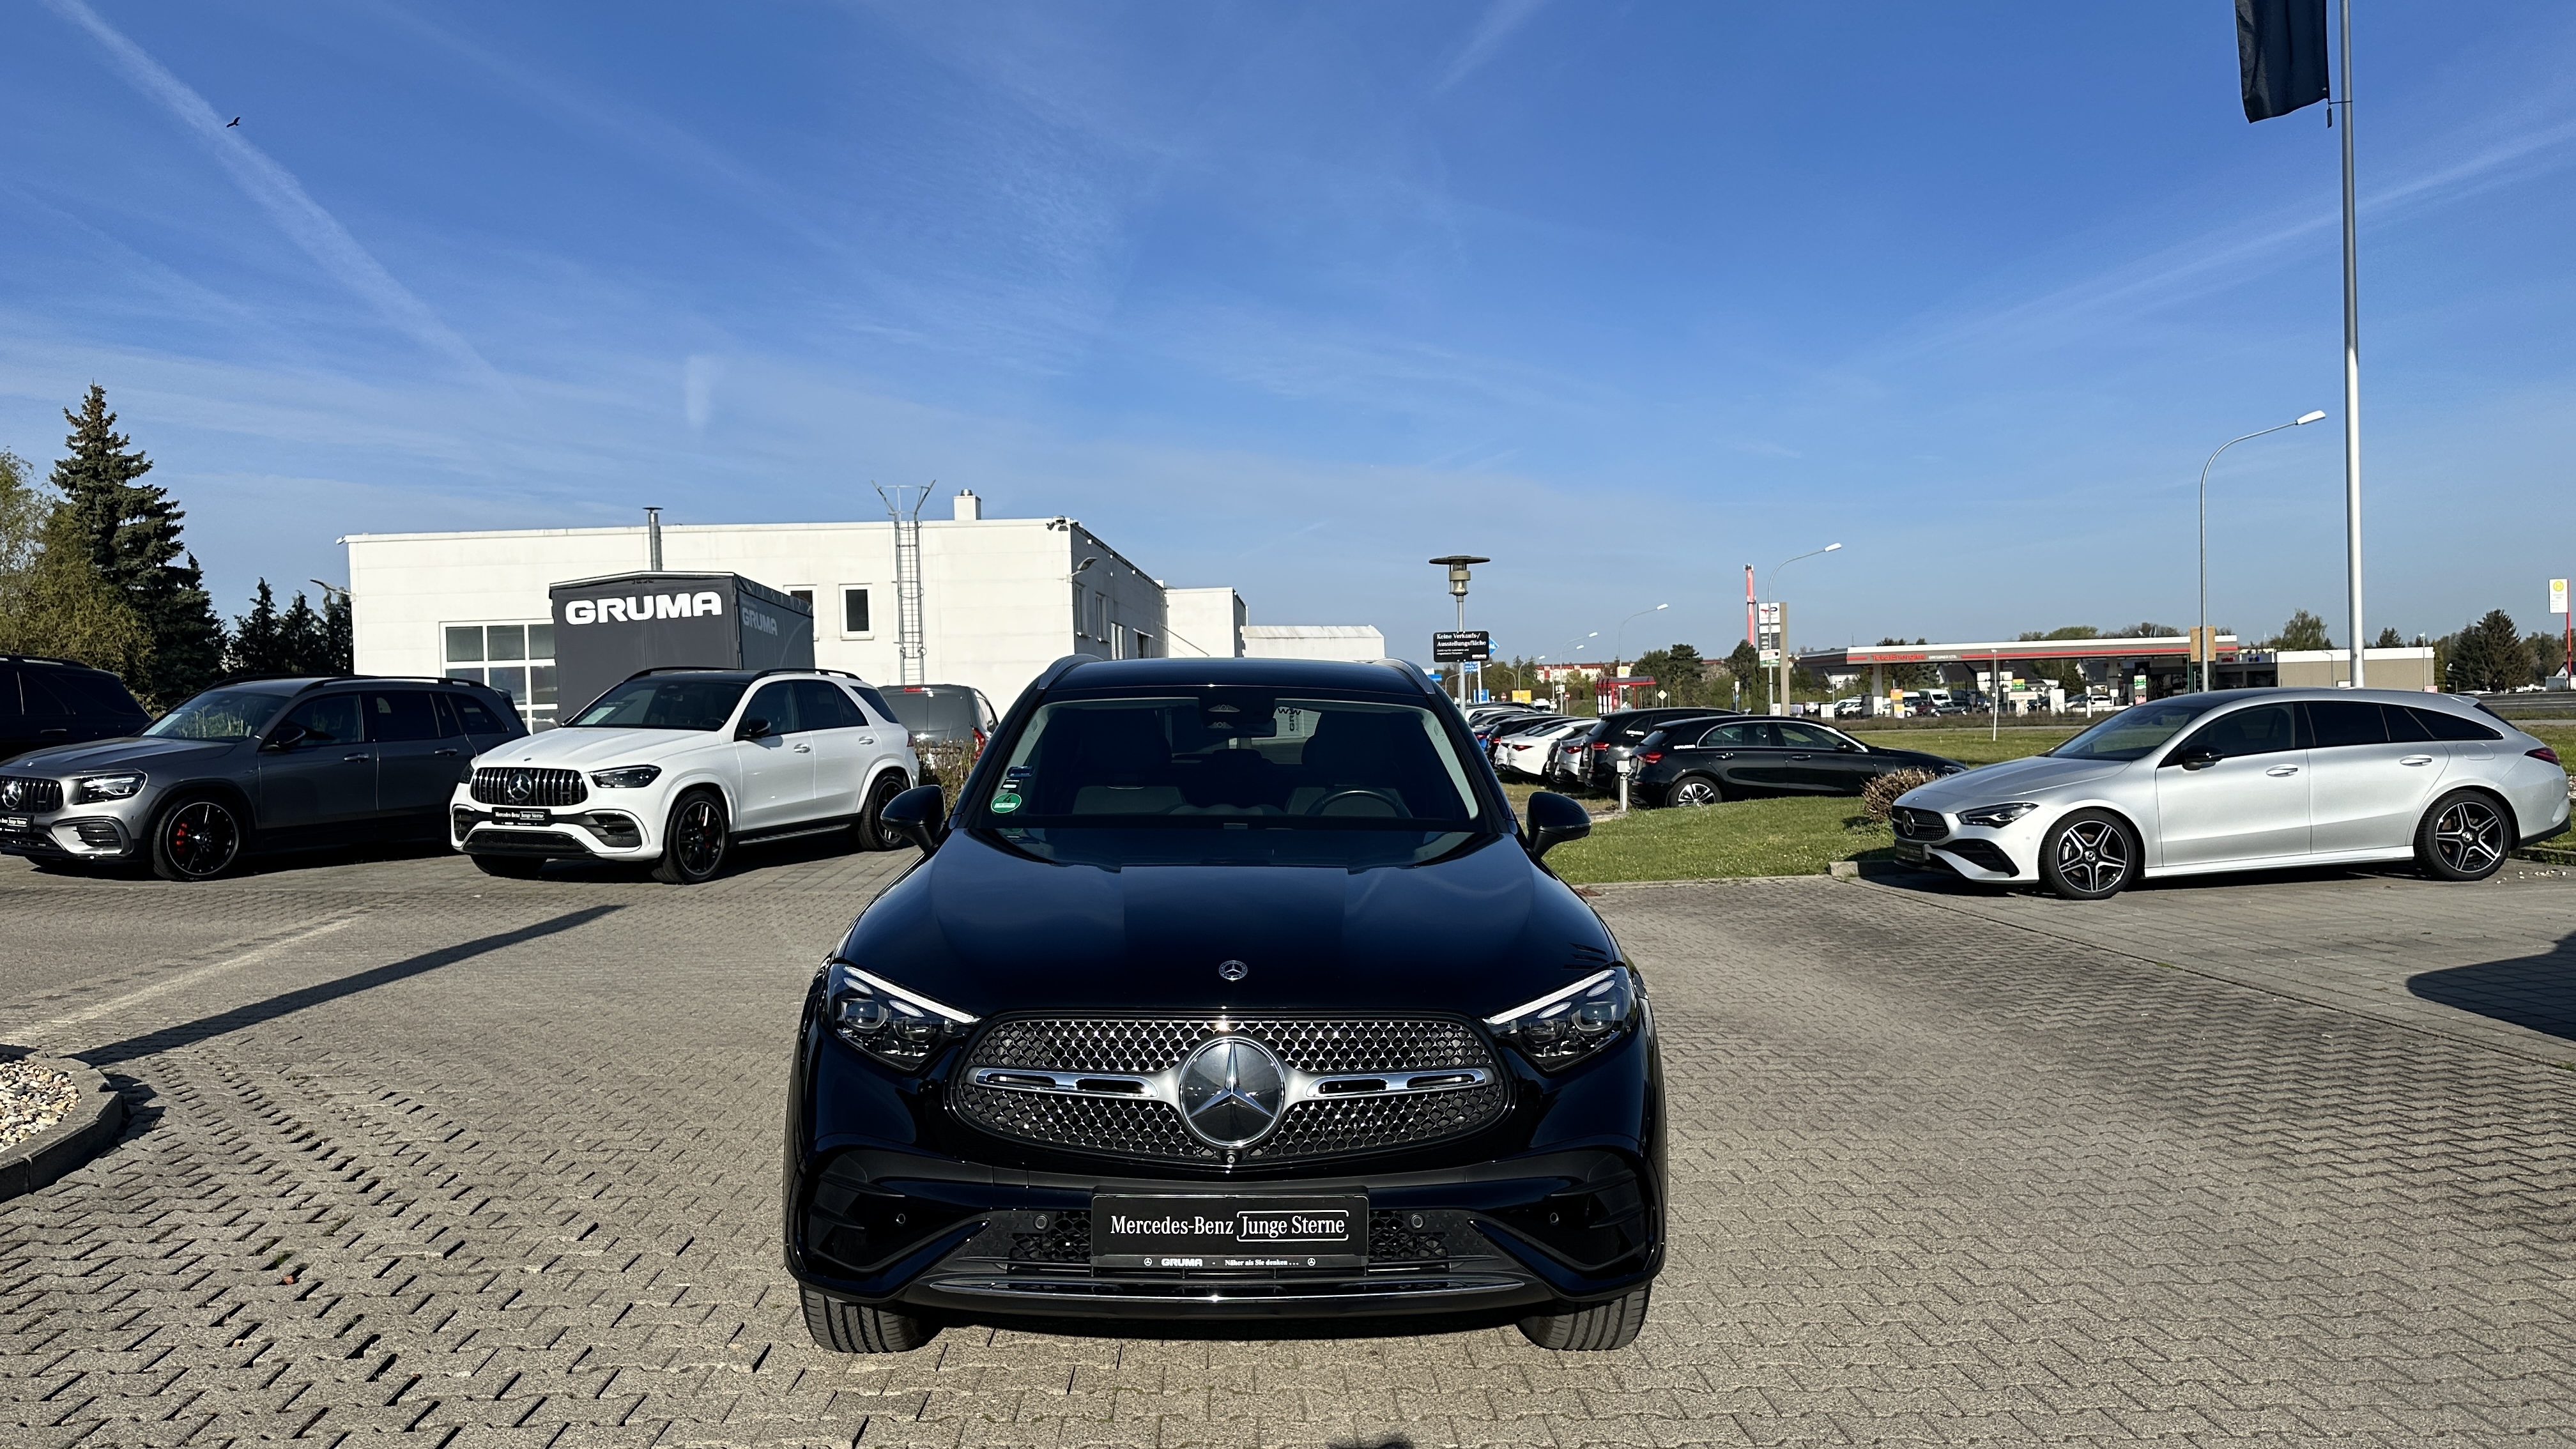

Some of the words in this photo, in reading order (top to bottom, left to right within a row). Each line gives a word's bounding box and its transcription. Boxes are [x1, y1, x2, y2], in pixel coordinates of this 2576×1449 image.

[565, 591, 723, 625] GRUMA
[742, 607, 778, 636] GRUMA
[1003, 794, 1012, 803] 4
[1110, 1215, 1234, 1234] Mercedes-Benz
[1241, 1216, 1287, 1238] Junge
[1291, 1215, 1345, 1234] Sterne
[1161, 1258, 1203, 1267] GRUMA
